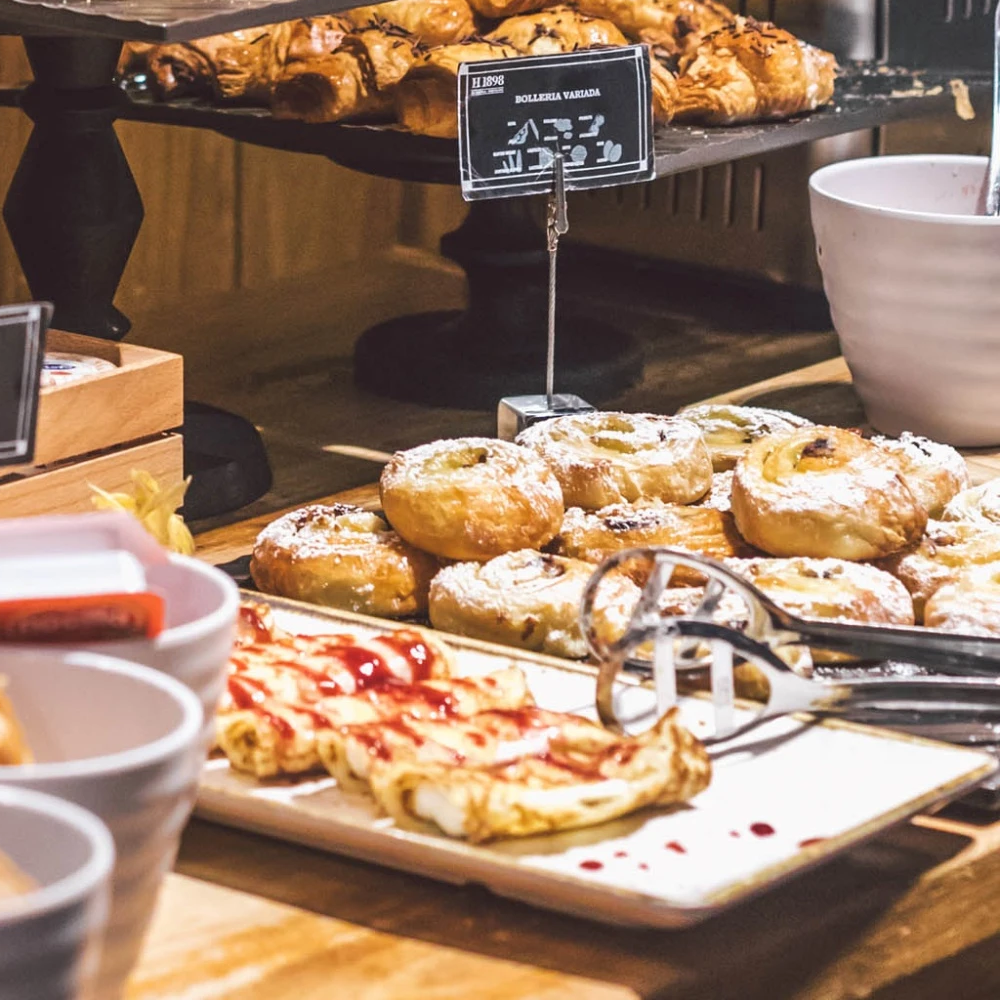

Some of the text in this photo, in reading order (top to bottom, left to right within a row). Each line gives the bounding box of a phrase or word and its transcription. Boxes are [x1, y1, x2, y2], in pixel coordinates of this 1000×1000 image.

[482, 75, 504, 87] 1898
[515, 88, 601, 103] BOLLERIA VARIADA
